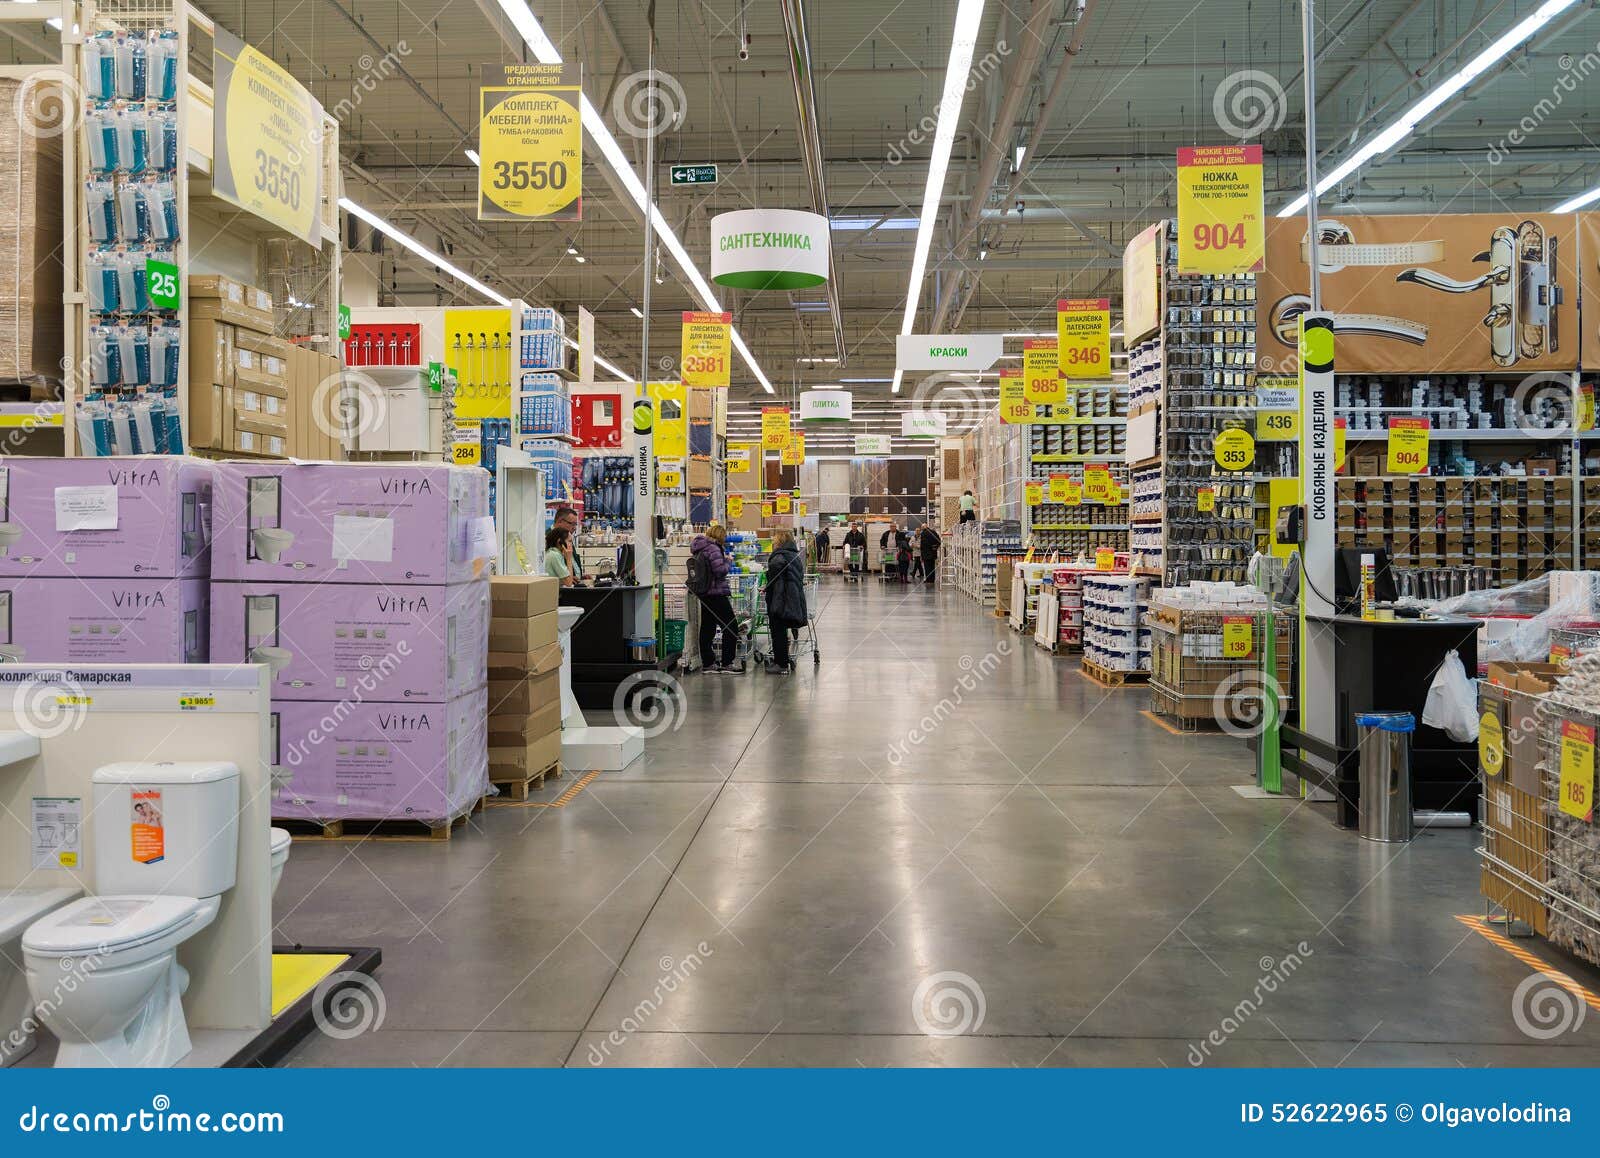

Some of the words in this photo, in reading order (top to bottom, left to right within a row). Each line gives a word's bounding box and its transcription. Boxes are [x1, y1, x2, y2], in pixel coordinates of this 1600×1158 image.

[504, 65, 564, 75] ПРЕДЛОЖЕНИЕ
[507, 76, 560, 86] ОГРАНИЧЕНО!
[503, 100, 559, 111] КОМПЛЕКТ
[489, 115, 531, 125] МЕБЕЛИ
[534, 115, 573, 125] «ЛИНА»
[561, 149, 578, 157] РУБ.
[1193, 156, 1224, 165] КАЖДЫЙ
[1225, 155, 1246, 164] ДЕНЬ!
[254, 149, 300, 212] 3550
[492, 160, 567, 190] 3550
[1202, 172, 1239, 182] НОЖКА
[720, 232, 812, 252] САНТЕХНИКА
[1193, 222, 1247, 250] 904
[151, 271, 177, 298] 25
[338, 312, 350, 332] 24
[930, 347, 968, 357] КРАСКИ
[1068, 347, 1101, 365] 346
[686, 356, 724, 373] 2581
[430, 368, 440, 385] 24
[1031, 378, 1058, 393] 985
[812, 400, 840, 409] ПЛИТКА
[1008, 405, 1030, 417] 195
[1056, 407, 1070, 415] 568
[1266, 415, 1293, 429] 436
[1313, 390, 1328, 449] ИЗДЕЛИЯ
[767, 434, 785, 444] 367
[456, 447, 474, 459] 284
[1223, 450, 1246, 463] 353
[1396, 452, 1420, 464] 904
[108, 469, 161, 486] VitrA
[639, 445, 648, 497] САНТЕХНИКА
[380, 477, 432, 495] VitrA
[1313, 452, 1326, 521] СКОБЯНЫЕ
[112, 591, 166, 608] VitrA
[376, 596, 430, 613] VitrA
[1230, 641, 1246, 652] 138
[0, 672, 61, 684] коллекция
[65, 670, 132, 684] Самарская
[378, 713, 431, 730] VitrA
[1566, 781, 1585, 805] 185
